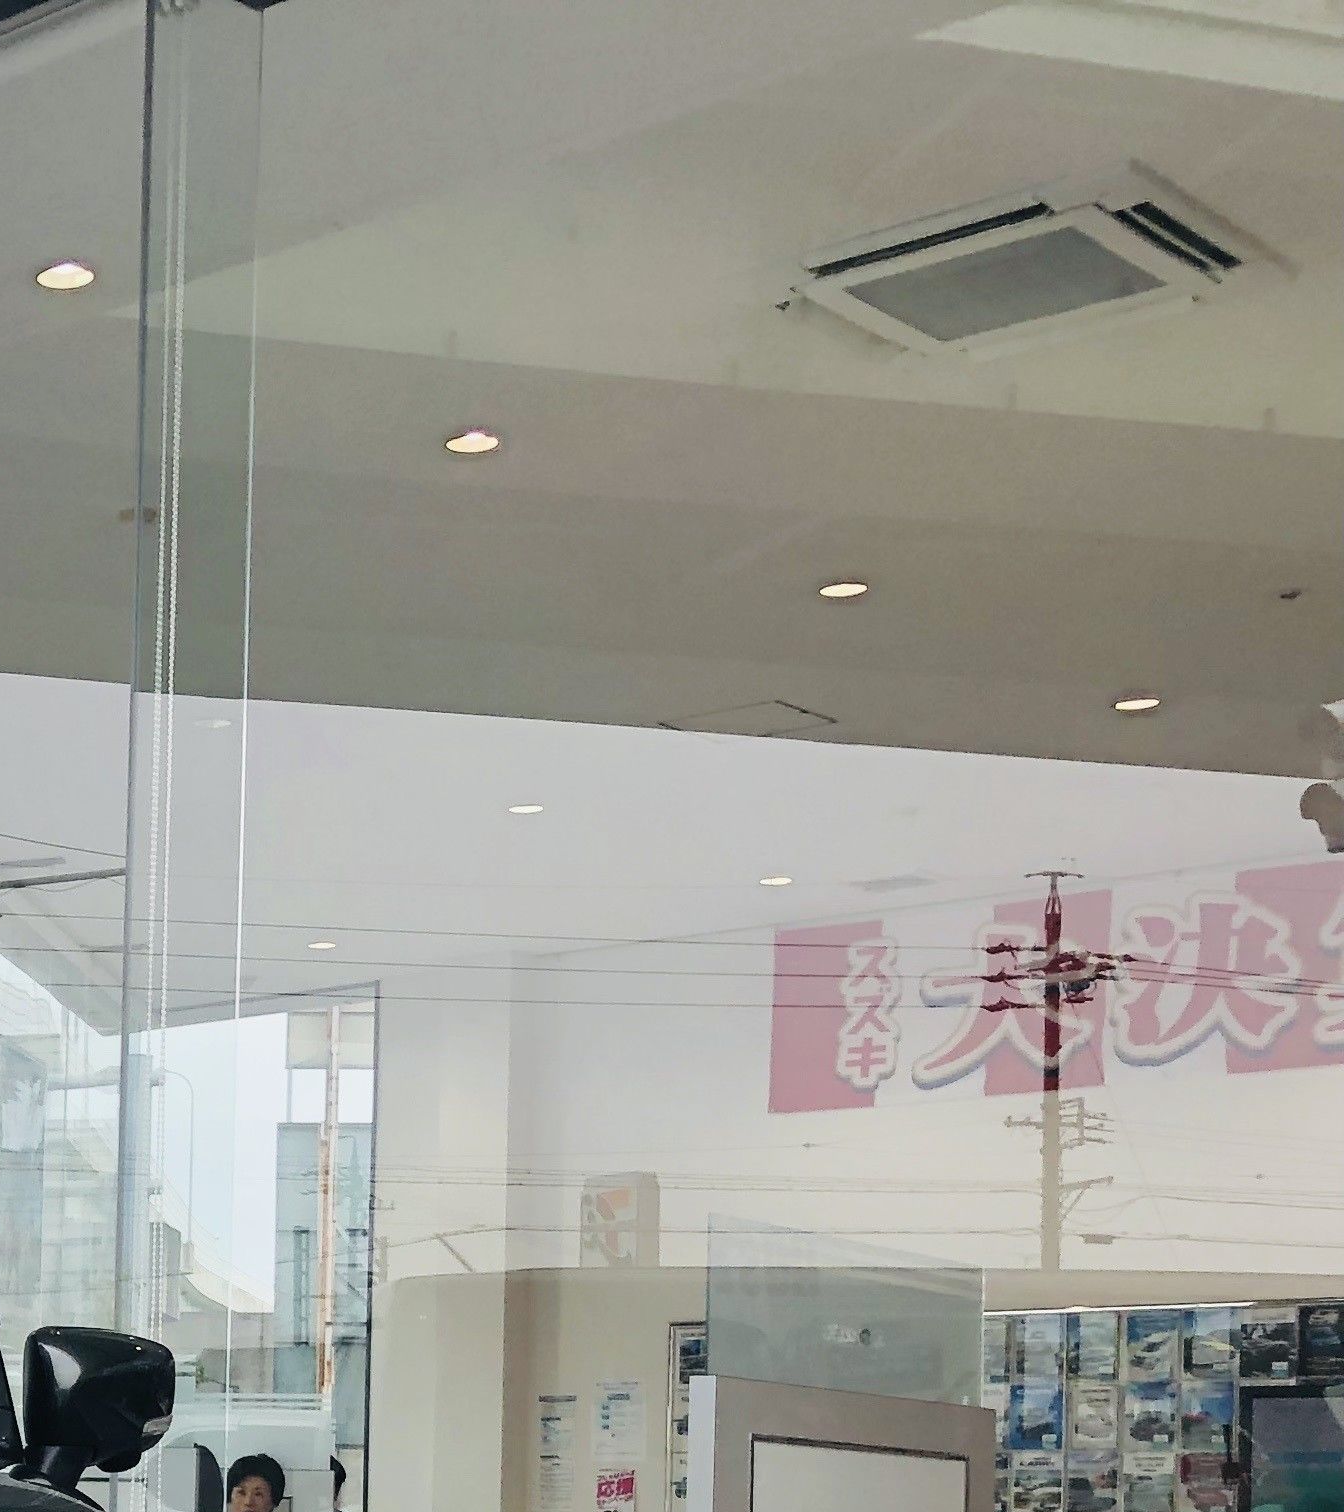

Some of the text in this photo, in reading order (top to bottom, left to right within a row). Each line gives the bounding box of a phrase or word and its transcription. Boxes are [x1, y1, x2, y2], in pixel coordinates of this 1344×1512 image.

[842, 943, 897, 1081] スズキ
[915, 893, 1344, 1084] 大決
